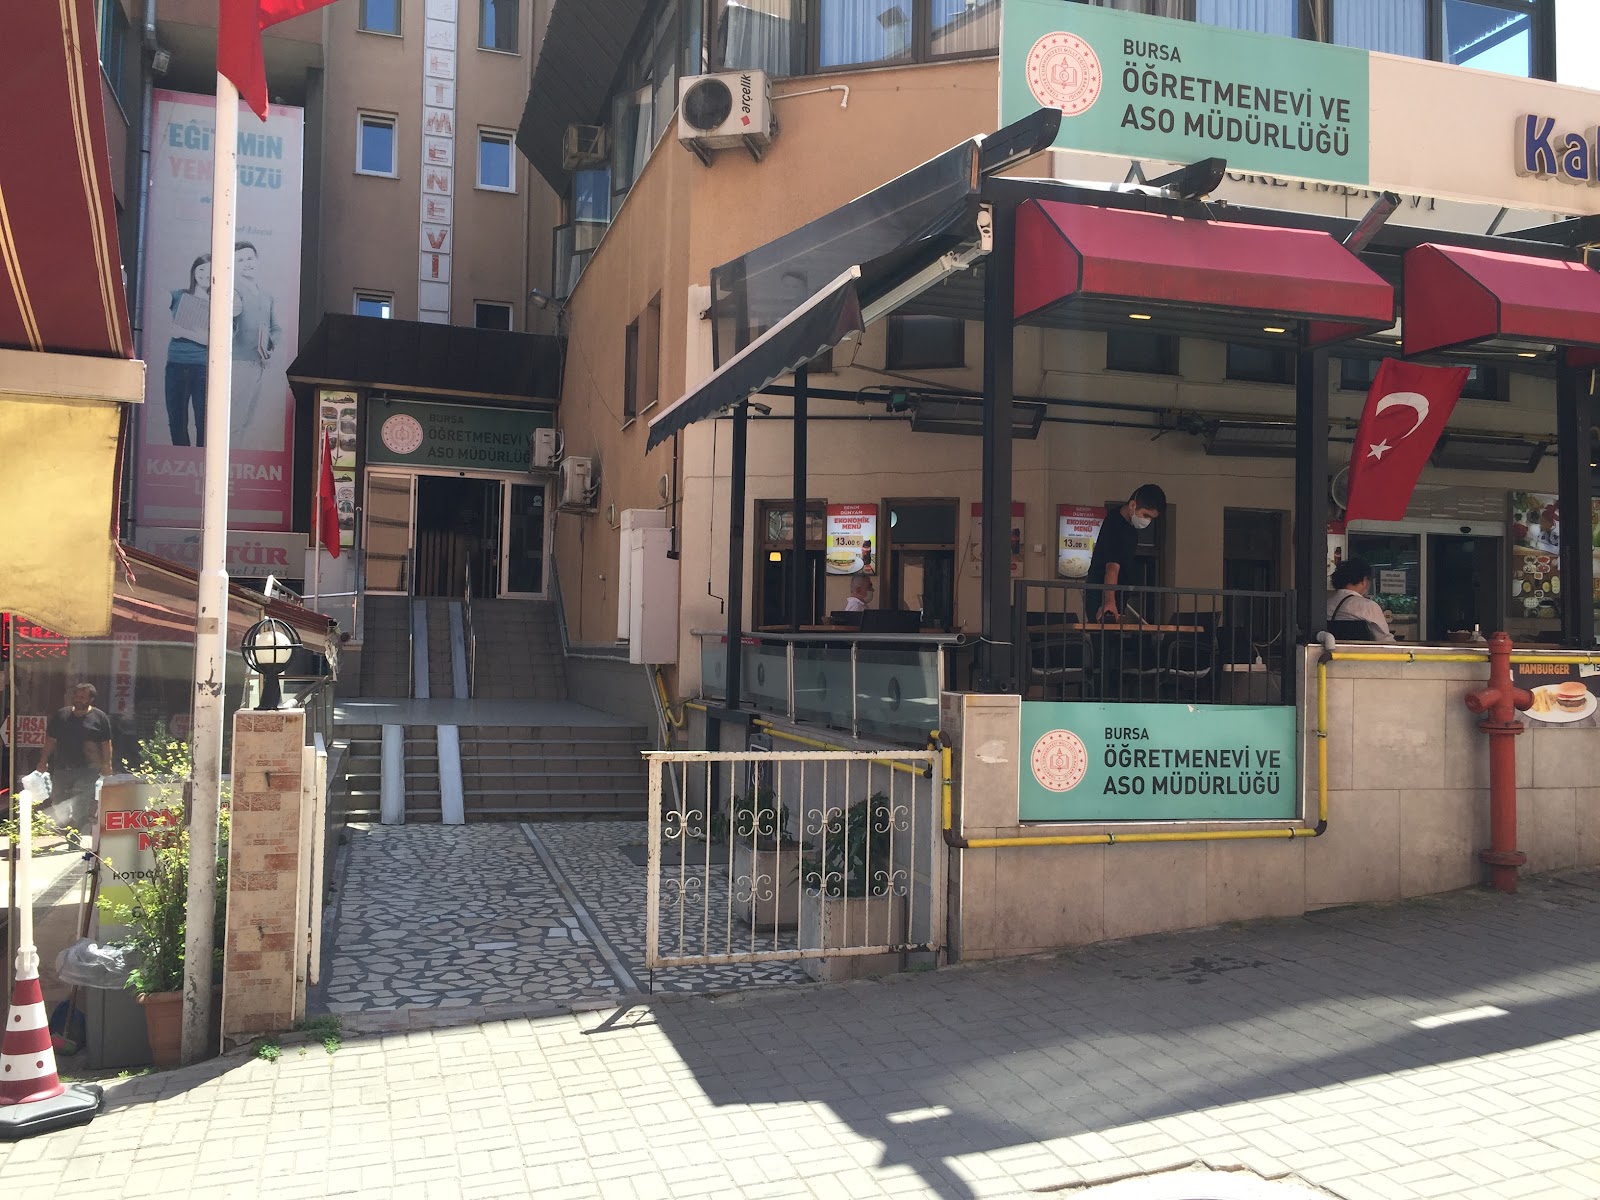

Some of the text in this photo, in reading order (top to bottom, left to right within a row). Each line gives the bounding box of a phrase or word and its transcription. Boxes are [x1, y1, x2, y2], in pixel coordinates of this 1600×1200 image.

[1123, 38, 1181, 62] BURSA
[741, 74, 753, 113] arçelik
[1122, 60, 1350, 123] ÖĞRETMENEVİ VE
[1120, 103, 1349, 156] ASO MÜDÜRLÜĞÜ
[1521, 113, 1600, 183] Ka
[168, 156, 282, 190] YEN ÜZÜ
[429, 414, 464, 424] BURSA
[428, 425, 522, 445] ÖĞRETMENEVİ
[427, 446, 531, 464] ASO MÜDÜRLÜĞ
[834, 516, 870, 524] EKONOMİK
[836, 537, 855, 546] 13.00
[1519, 664, 1570, 675] HAMBURGER
[1104, 727, 1149, 740] BURSA
[1104, 743, 1281, 768] ÖĞRETMENEVİ VE
[1103, 770, 1280, 795] ASO MÜDÜRLÜĞÜ
